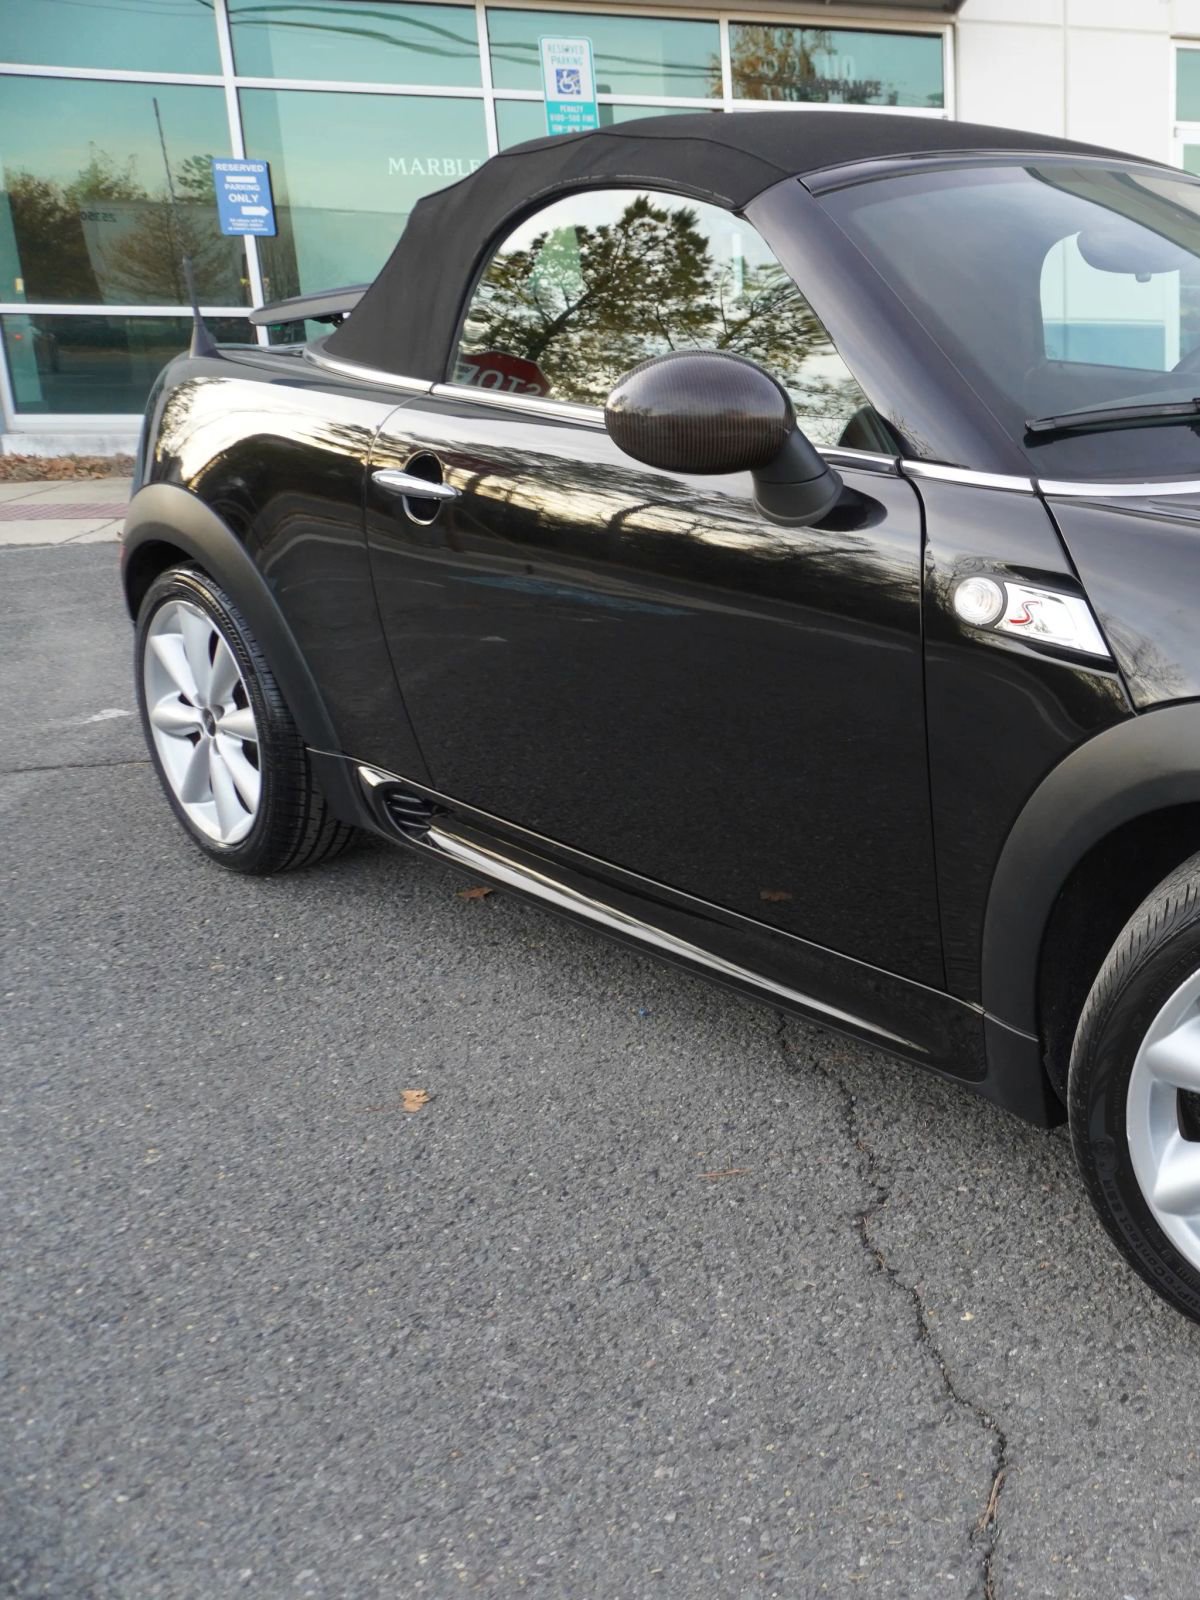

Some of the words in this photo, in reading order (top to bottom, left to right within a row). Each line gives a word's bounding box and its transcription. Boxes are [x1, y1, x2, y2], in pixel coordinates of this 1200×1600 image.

[215, 163, 264, 173] RESERVED
[224, 183, 261, 192] PARKING
[228, 193, 259, 204] ONLY
